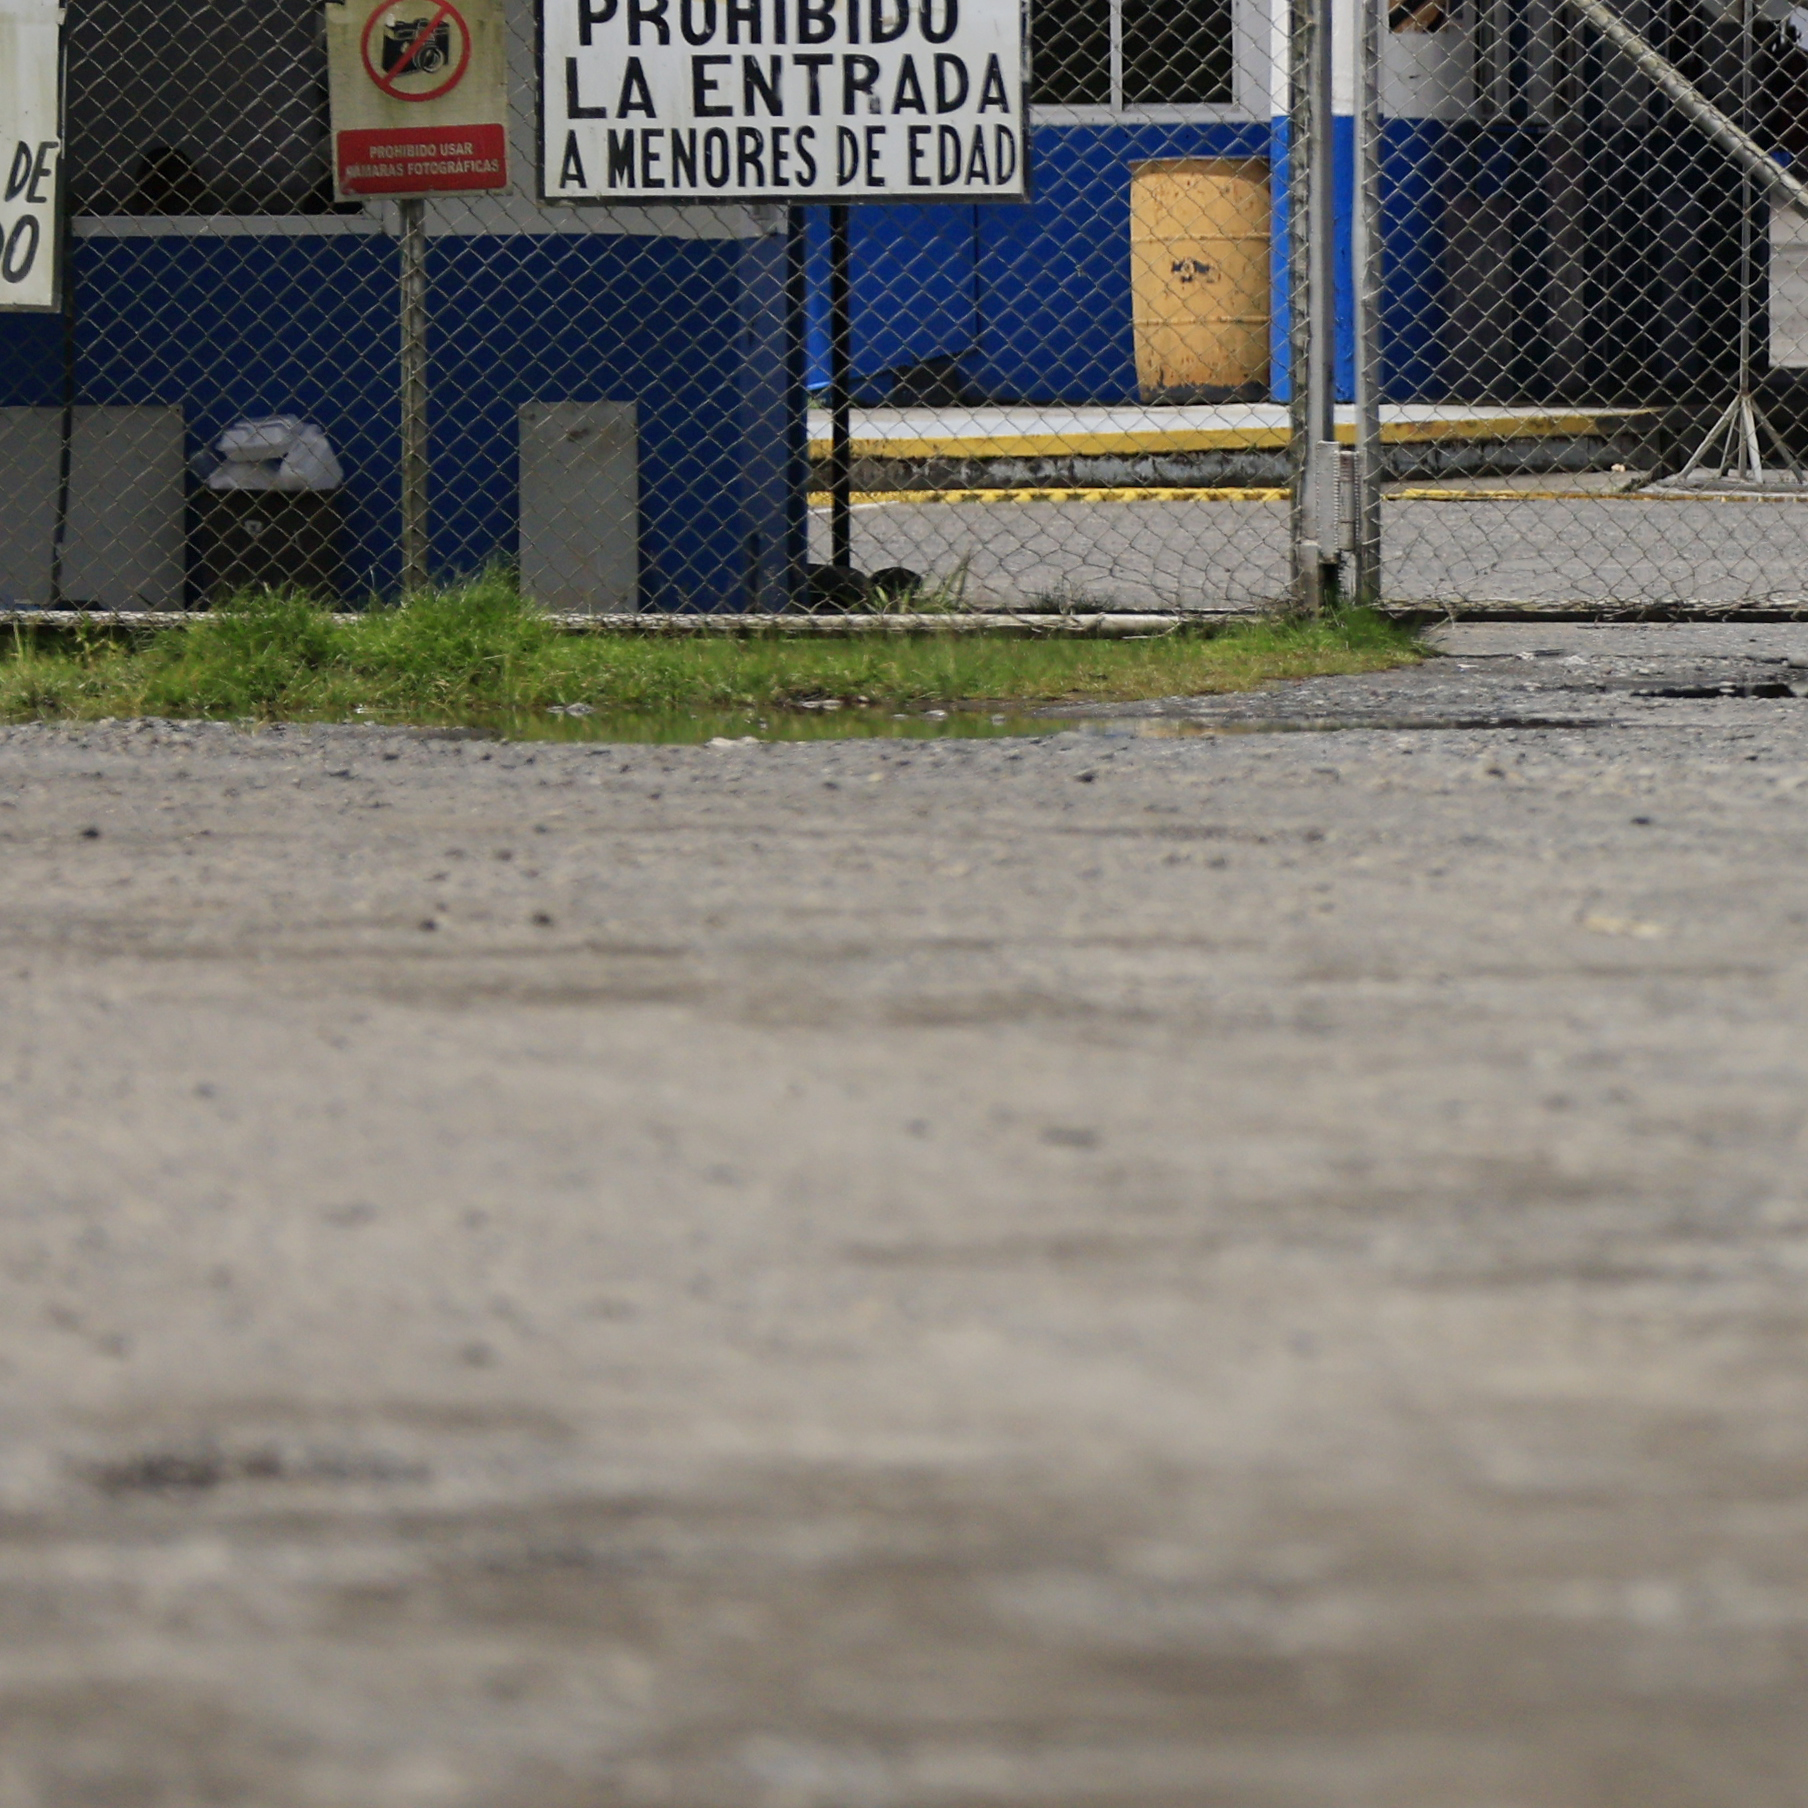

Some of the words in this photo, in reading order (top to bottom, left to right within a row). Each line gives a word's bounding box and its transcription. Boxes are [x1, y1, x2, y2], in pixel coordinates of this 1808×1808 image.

[565, 56, 657, 120] LA
[691, 53, 1011, 118] ENTRADA
[5, 140, 59, 204] DE
[369, 144, 437, 159] PROHIBIDO
[440, 142, 473, 156] USAR
[559, 129, 588, 188] A
[607, 125, 816, 188] MENORES
[837, 124, 886, 187] DE
[908, 123, 1016, 187] EDAD
